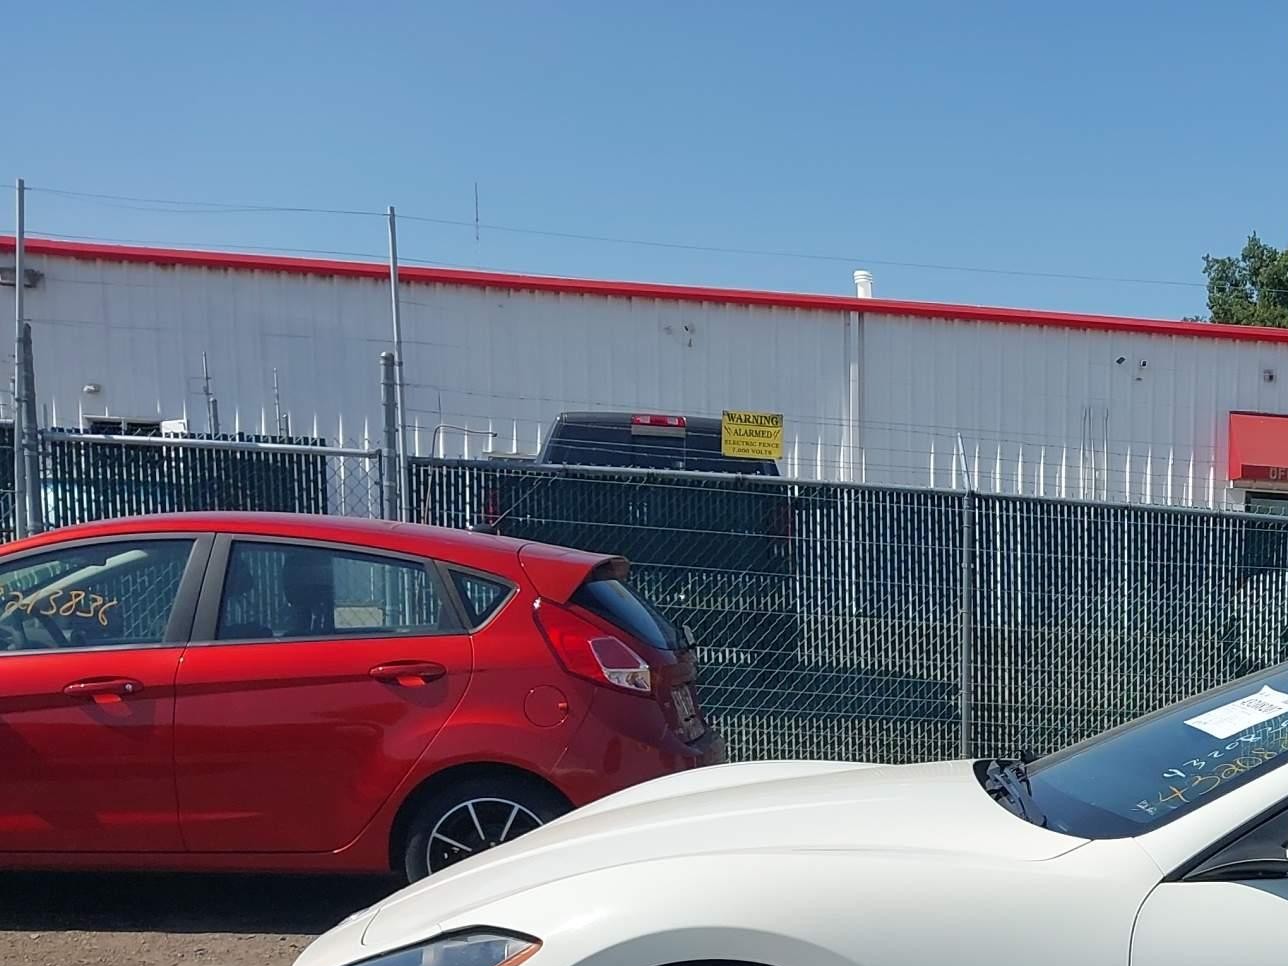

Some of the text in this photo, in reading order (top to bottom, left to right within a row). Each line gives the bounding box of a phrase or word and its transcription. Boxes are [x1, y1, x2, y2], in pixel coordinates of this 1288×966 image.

[727, 412, 779, 425] WARNING
[733, 428, 773, 439] ALARMED
[725, 440, 757, 448] ELECTRIC
[751, 448, 772, 456] VOLTS
